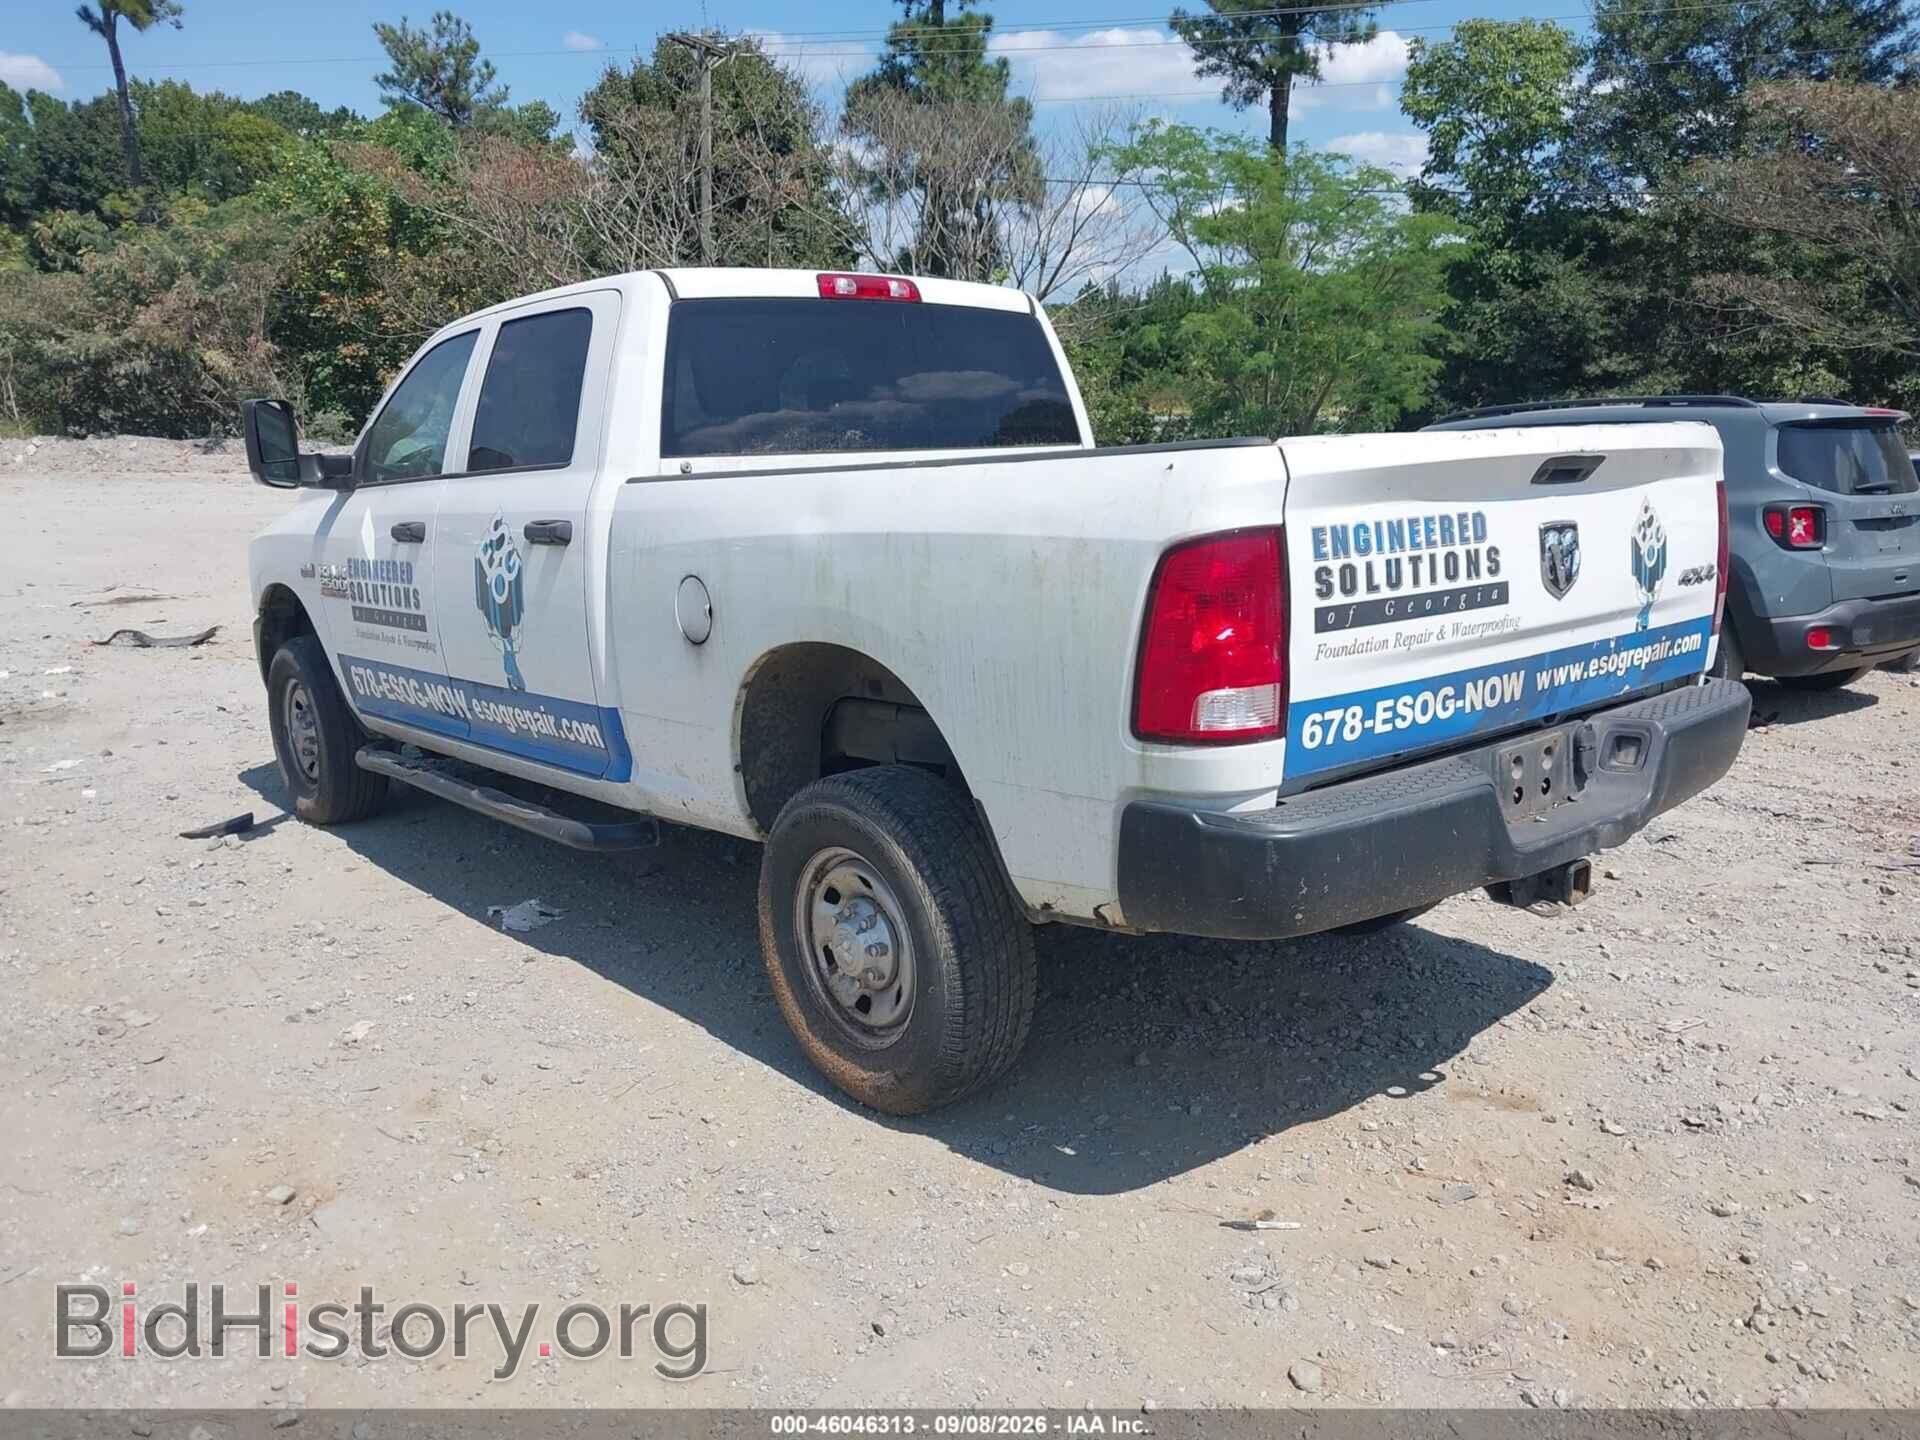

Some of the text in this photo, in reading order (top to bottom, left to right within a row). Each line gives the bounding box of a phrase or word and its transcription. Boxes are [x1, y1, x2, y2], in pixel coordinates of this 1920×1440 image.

[1312, 510, 1488, 561] ENGINEERED
[346, 557, 414, 585] ENGINEERED
[349, 581, 421, 610] SOLUTIONS
[1314, 546, 1501, 601] SOLUTIONS
[1327, 588, 1499, 628] of Georgia
[1314, 614, 1521, 661] Foundation Repair & Waterproofing
[350, 665, 606, 749] 678-ESOG-NOW esogrepair.com
[1301, 632, 1702, 750] 678-ESOG-NOW www.esogrepair.com
